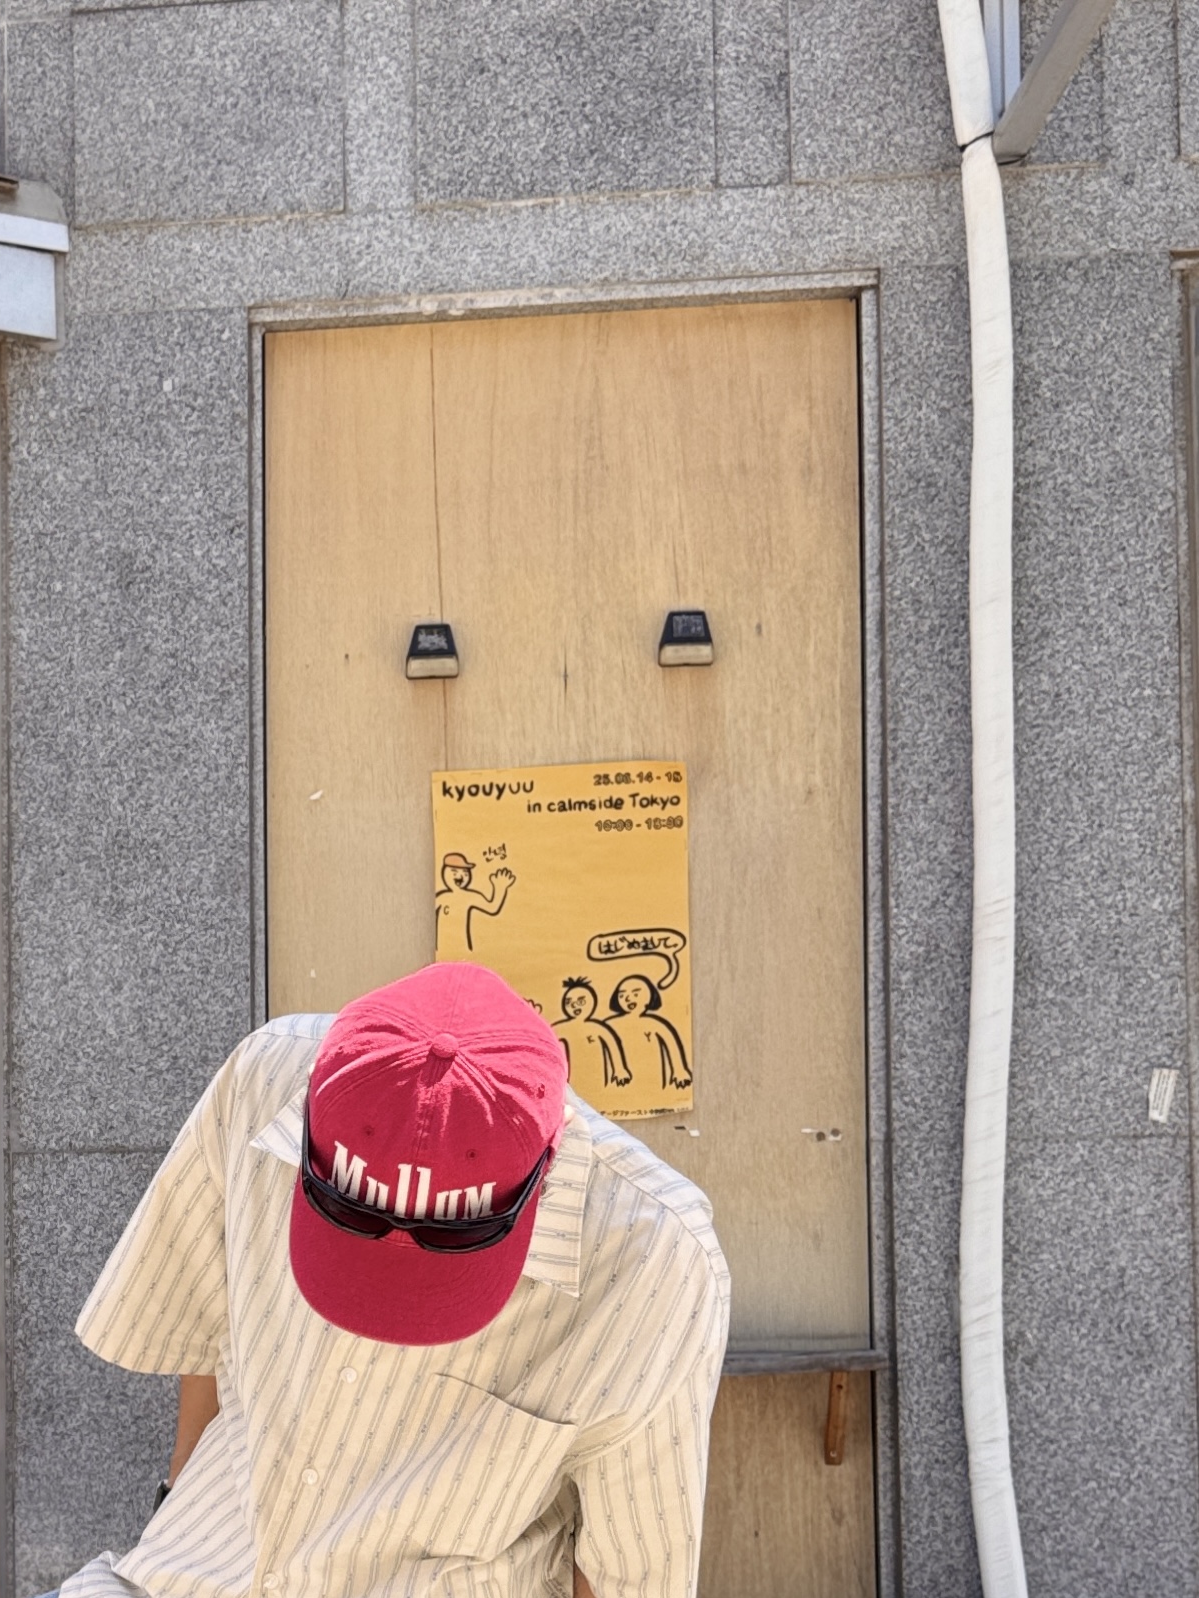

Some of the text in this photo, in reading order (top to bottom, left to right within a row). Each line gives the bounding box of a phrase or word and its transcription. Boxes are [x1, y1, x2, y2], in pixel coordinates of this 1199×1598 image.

[442, 780, 534, 802] kyouyuu
[527, 792, 681, 813] in calmside Tokyo
